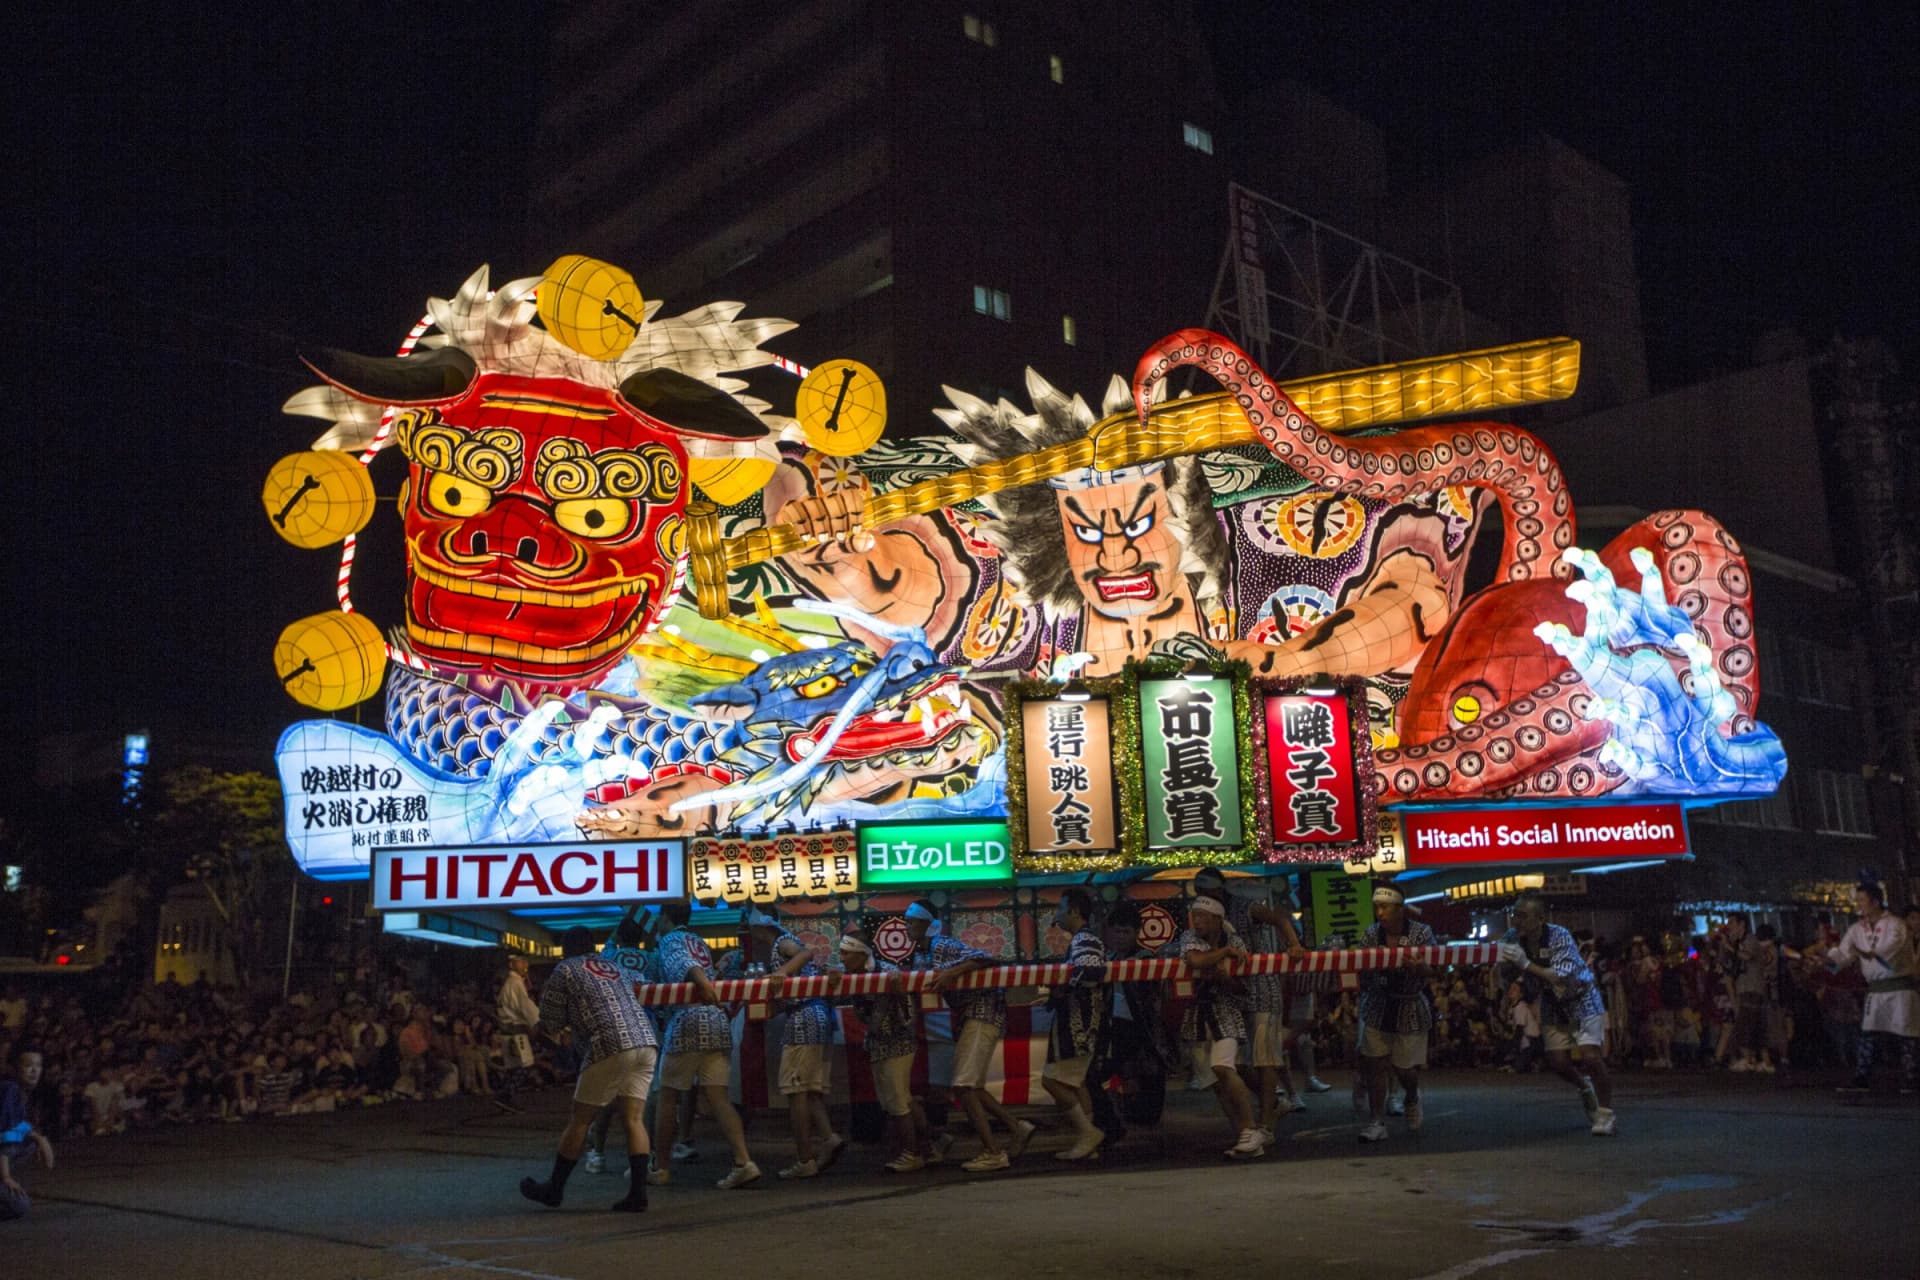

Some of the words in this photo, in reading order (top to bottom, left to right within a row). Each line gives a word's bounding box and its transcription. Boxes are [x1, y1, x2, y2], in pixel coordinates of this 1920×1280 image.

[301, 764, 402, 794] 吹越村の
[1159, 686, 1224, 840] 市長賞
[1281, 703, 1342, 836] 囃子賞
[302, 794, 428, 829] 火消し権現
[1379, 835, 1397, 864] 日立
[1416, 826, 1490, 850] Hitachi
[1497, 823, 1558, 847] Social
[1565, 819, 1675, 844] Innovation
[834, 854, 852, 886] 日立
[866, 840, 1005, 871] 日立のLED
[390, 848, 669, 901] HITACHI
[694, 859, 713, 891] 日立
[725, 863, 744, 895] 日立
[751, 865, 770, 896] 日立
[780, 857, 799, 889] 日立
[809, 858, 828, 890] 日立
